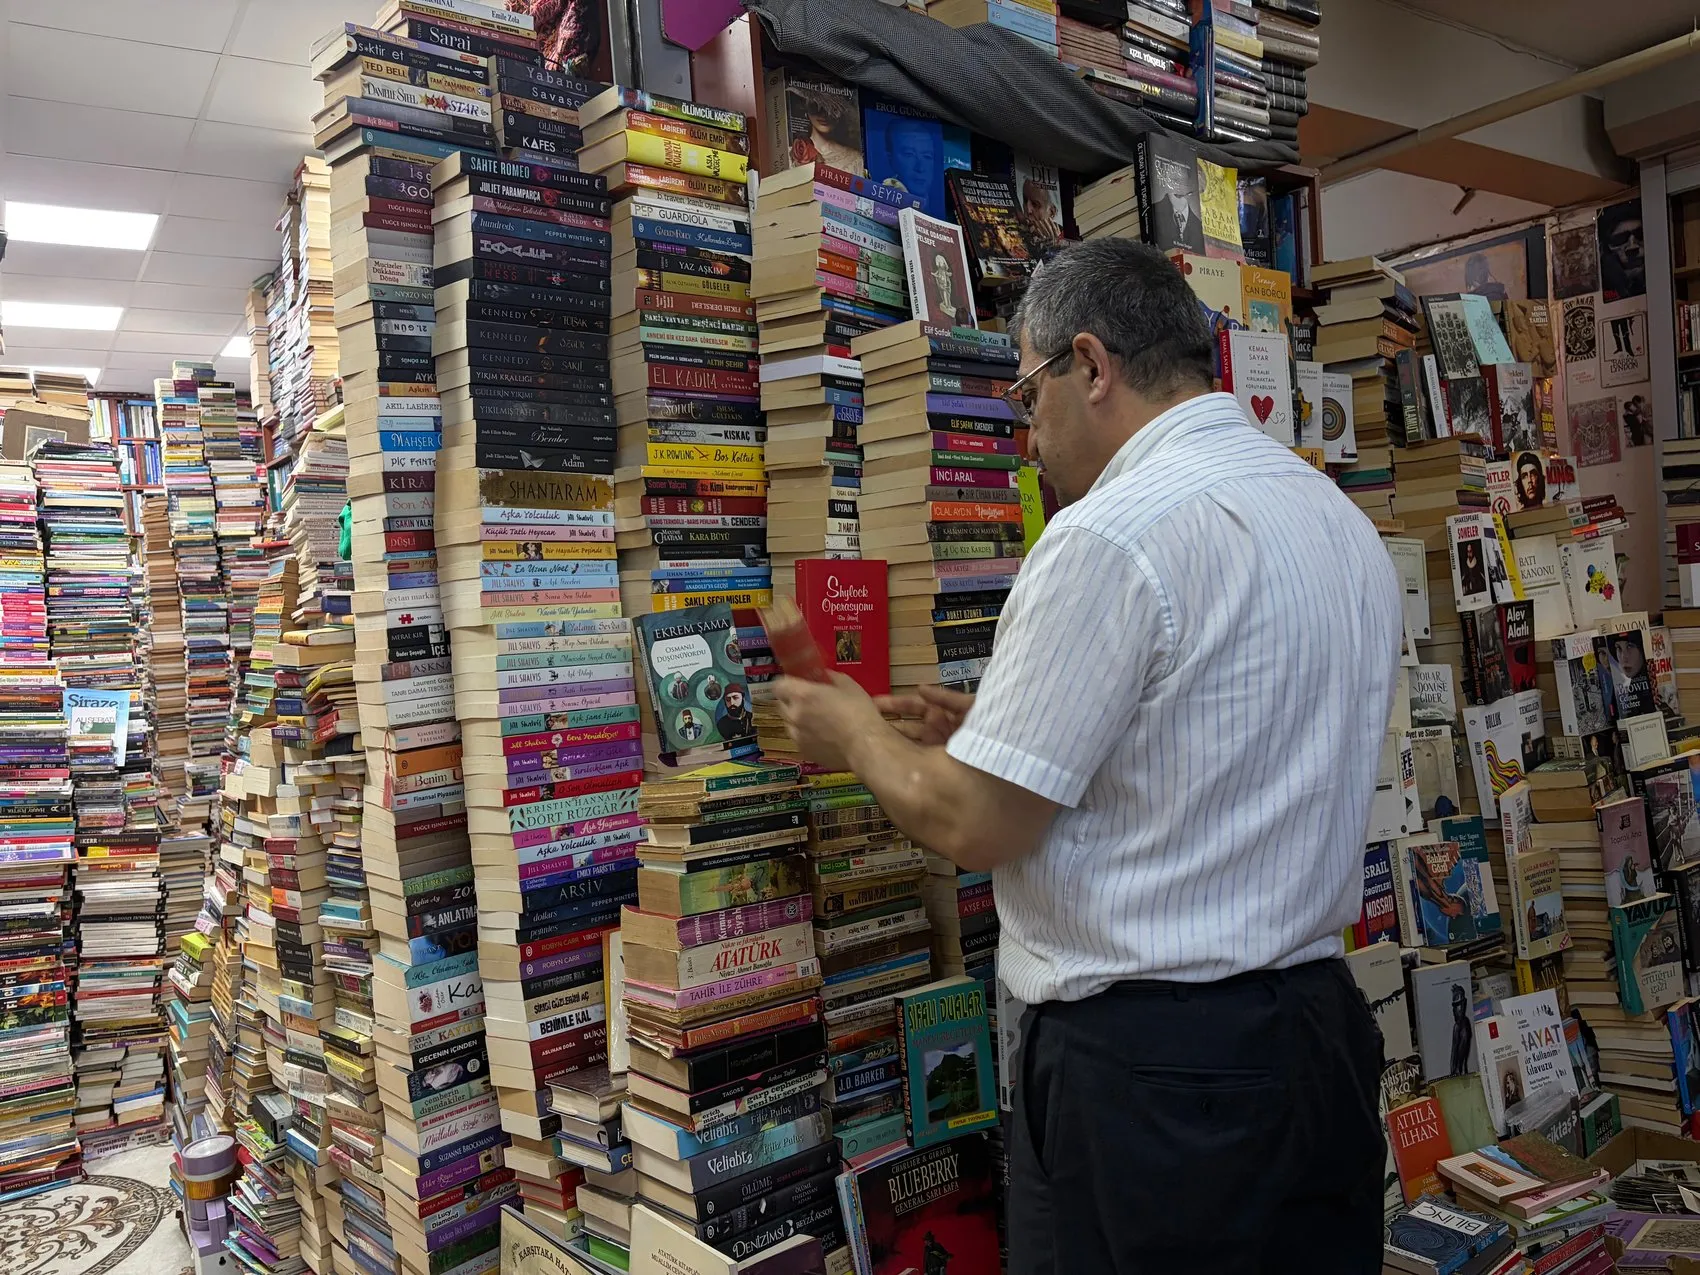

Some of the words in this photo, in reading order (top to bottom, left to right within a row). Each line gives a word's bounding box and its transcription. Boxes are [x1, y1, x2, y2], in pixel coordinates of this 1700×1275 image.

[491, 10, 506, 22] Emile
[506, 13, 520, 24] Zola
[1129, 48, 1144, 60] KIZIL
[364, 60, 383, 74] TED
[386, 64, 407, 78] BELL
[526, 66, 589, 93] Yabancı
[788, 76, 819, 92] Jennifer
[820, 81, 854, 99] Donnelly
[448, 102, 479, 117] STAR
[876, 102, 898, 115] EROL
[660, 124, 687, 136] LABİRENT
[690, 128, 708, 141] ÖLÜM
[709, 132, 726, 145] EMRİ
[522, 136, 556, 153] KAFES
[470, 156, 498, 174] SAHTE
[500, 161, 530, 179] ROMEO
[820, 168, 850, 185] PİRAYE
[479, 180, 500, 196] JULIET
[502, 184, 541, 203] PARAMPARÇA
[872, 184, 903, 205] SEYİR
[658, 210, 709, 227] GUARDIOLA
[1205, 208, 1235, 225] ABAM
[480, 218, 515, 232] hundreds
[826, 222, 848, 239] Sarah
[1204, 218, 1236, 234] ULTAN
[545, 230, 568, 239] PEPPER
[570, 232, 593, 243] WINTERS
[679, 261, 695, 271] YAZ
[698, 264, 724, 276] AŞKIM
[1200, 266, 1225, 278] PİRAYE
[702, 280, 731, 292] GÖLGELER
[1244, 284, 1260, 296] CAN
[1262, 286, 1287, 300] BORCU
[481, 307, 527, 320] KENNEDY
[480, 330, 528, 343] KENNEDY
[1248, 345, 1269, 353] KEMAL
[654, 367, 670, 385] EL
[676, 368, 718, 390] KADİM
[1404, 404, 1419, 434] ALAMUT
[391, 434, 434, 450] MAHŞER
[724, 429, 751, 442] KISKAÇ
[562, 459, 585, 468] Adam
[654, 450, 666, 460] J.K.
[731, 450, 755, 463] Koltuk
[936, 470, 953, 482] İNCİ
[954, 472, 976, 483] ARAL
[1546, 466, 1577, 485] KING
[510, 481, 598, 502] SHANTARAM
[710, 482, 724, 492] Kimi
[834, 503, 853, 514] UYAN
[731, 516, 760, 527] CENDERE
[1454, 514, 1480, 525] SHAKESPEARE
[690, 532, 709, 541] KARA
[710, 531, 730, 541] BÜYÜ
[1457, 526, 1480, 540] SONELER
[515, 564, 526, 574] En
[528, 564, 548, 574] Uzun
[549, 564, 569, 574] Noel
[1518, 555, 1537, 567] BATI
[1520, 566, 1555, 580] KANONU
[826, 576, 869, 601] Shylock
[822, 598, 874, 615] Operasyonu
[946, 610, 962, 620] BUKET
[964, 608, 983, 618] UZUNER
[1506, 608, 1526, 623] Alev
[655, 625, 695, 639] EKREM
[698, 618, 730, 634] ŞAMA
[1508, 622, 1530, 639] Alatlı
[508, 642, 518, 651] JILL
[519, 640, 541, 651] SHALVIS
[665, 643, 696, 655] OSMANLI
[508, 674, 518, 684] JILL
[519, 673, 541, 684] SHALVIS
[942, 668, 959, 678] CANAN
[960, 666, 972, 676] TAN
[413, 678, 439, 687] Laurent
[1485, 712, 1502, 730] BOLLUK
[1406, 730, 1417, 738] Ayet
[1425, 729, 1443, 738] Slogan
[414, 772, 448, 788] Benim
[414, 794, 436, 803] Finansal
[438, 790, 462, 800] Piyasalar
[526, 800, 571, 814] KRISTIN
[575, 793, 619, 807] HANNAH
[528, 811, 563, 828] DÖRT
[568, 800, 619, 820] RÜZGÂR
[528, 864, 540, 874] JILL
[542, 860, 569, 872] SHALVIS
[1364, 864, 1390, 880] SRAİL
[559, 880, 604, 900] ARŞİV
[1364, 880, 1392, 897] ÖRGÜTLERİ
[592, 898, 613, 908] PEPPER
[614, 892, 638, 903] WINTERS
[964, 902, 980, 914] AYŞE
[1366, 896, 1394, 920] MOSSAD
[533, 910, 558, 923] dollars
[734, 906, 744, 936] Siyah
[966, 936, 987, 948] CANAN
[542, 958, 563, 970] ROBYN
[564, 954, 581, 965] CARR
[710, 938, 782, 973] ATATÜRK
[690, 984, 716, 1001] TAHİR
[719, 982, 732, 994] İLE
[734, 976, 763, 990] ZÜHRE
[908, 997, 938, 1033] ŞİFALI
[940, 989, 984, 1024] DUALAR
[540, 1015, 575, 1035] BENİMLE
[576, 1010, 592, 1024] KAL
[414, 1040, 434, 1051] KOCA
[418, 1048, 449, 1065] GECENİN
[449, 1039, 478, 1057] İÇİNDEN
[542, 1045, 562, 1057] ASLIHAN
[562, 1042, 576, 1051] DOĞA
[747, 1091, 768, 1104] garp
[769, 1071, 818, 1097] cephesinde
[839, 1077, 853, 1091] J.D.
[854, 1068, 885, 1088] BARKER
[424, 1089, 460, 1106] çemberin
[722, 1086, 745, 1098] TAGORE
[420, 1094, 466, 1116] dışındakiler
[702, 1108, 721, 1120] erich
[1396, 1102, 1437, 1131] ATTİLÂ
[1400, 1123, 1440, 1149] İLHAN
[438, 1147, 462, 1164] SUZANNE
[462, 1135, 495, 1156] BROCKMANN
[892, 1158, 920, 1174] CHARLIER
[929, 1146, 952, 1161] GIRAUD
[888, 1154, 960, 1204] BLUEBERRY
[895, 1196, 925, 1214] GENERAL
[926, 1189, 942, 1202] SARI
[943, 1181, 960, 1196] KAFA
[432, 1212, 460, 1229] Diamond
[438, 1209, 452, 1222] Lucy
[733, 1222, 785, 1259] DENİZİMSİ
[814, 1206, 834, 1223] AKSOY
[518, 1246, 555, 1262] KARŞIYAKA
